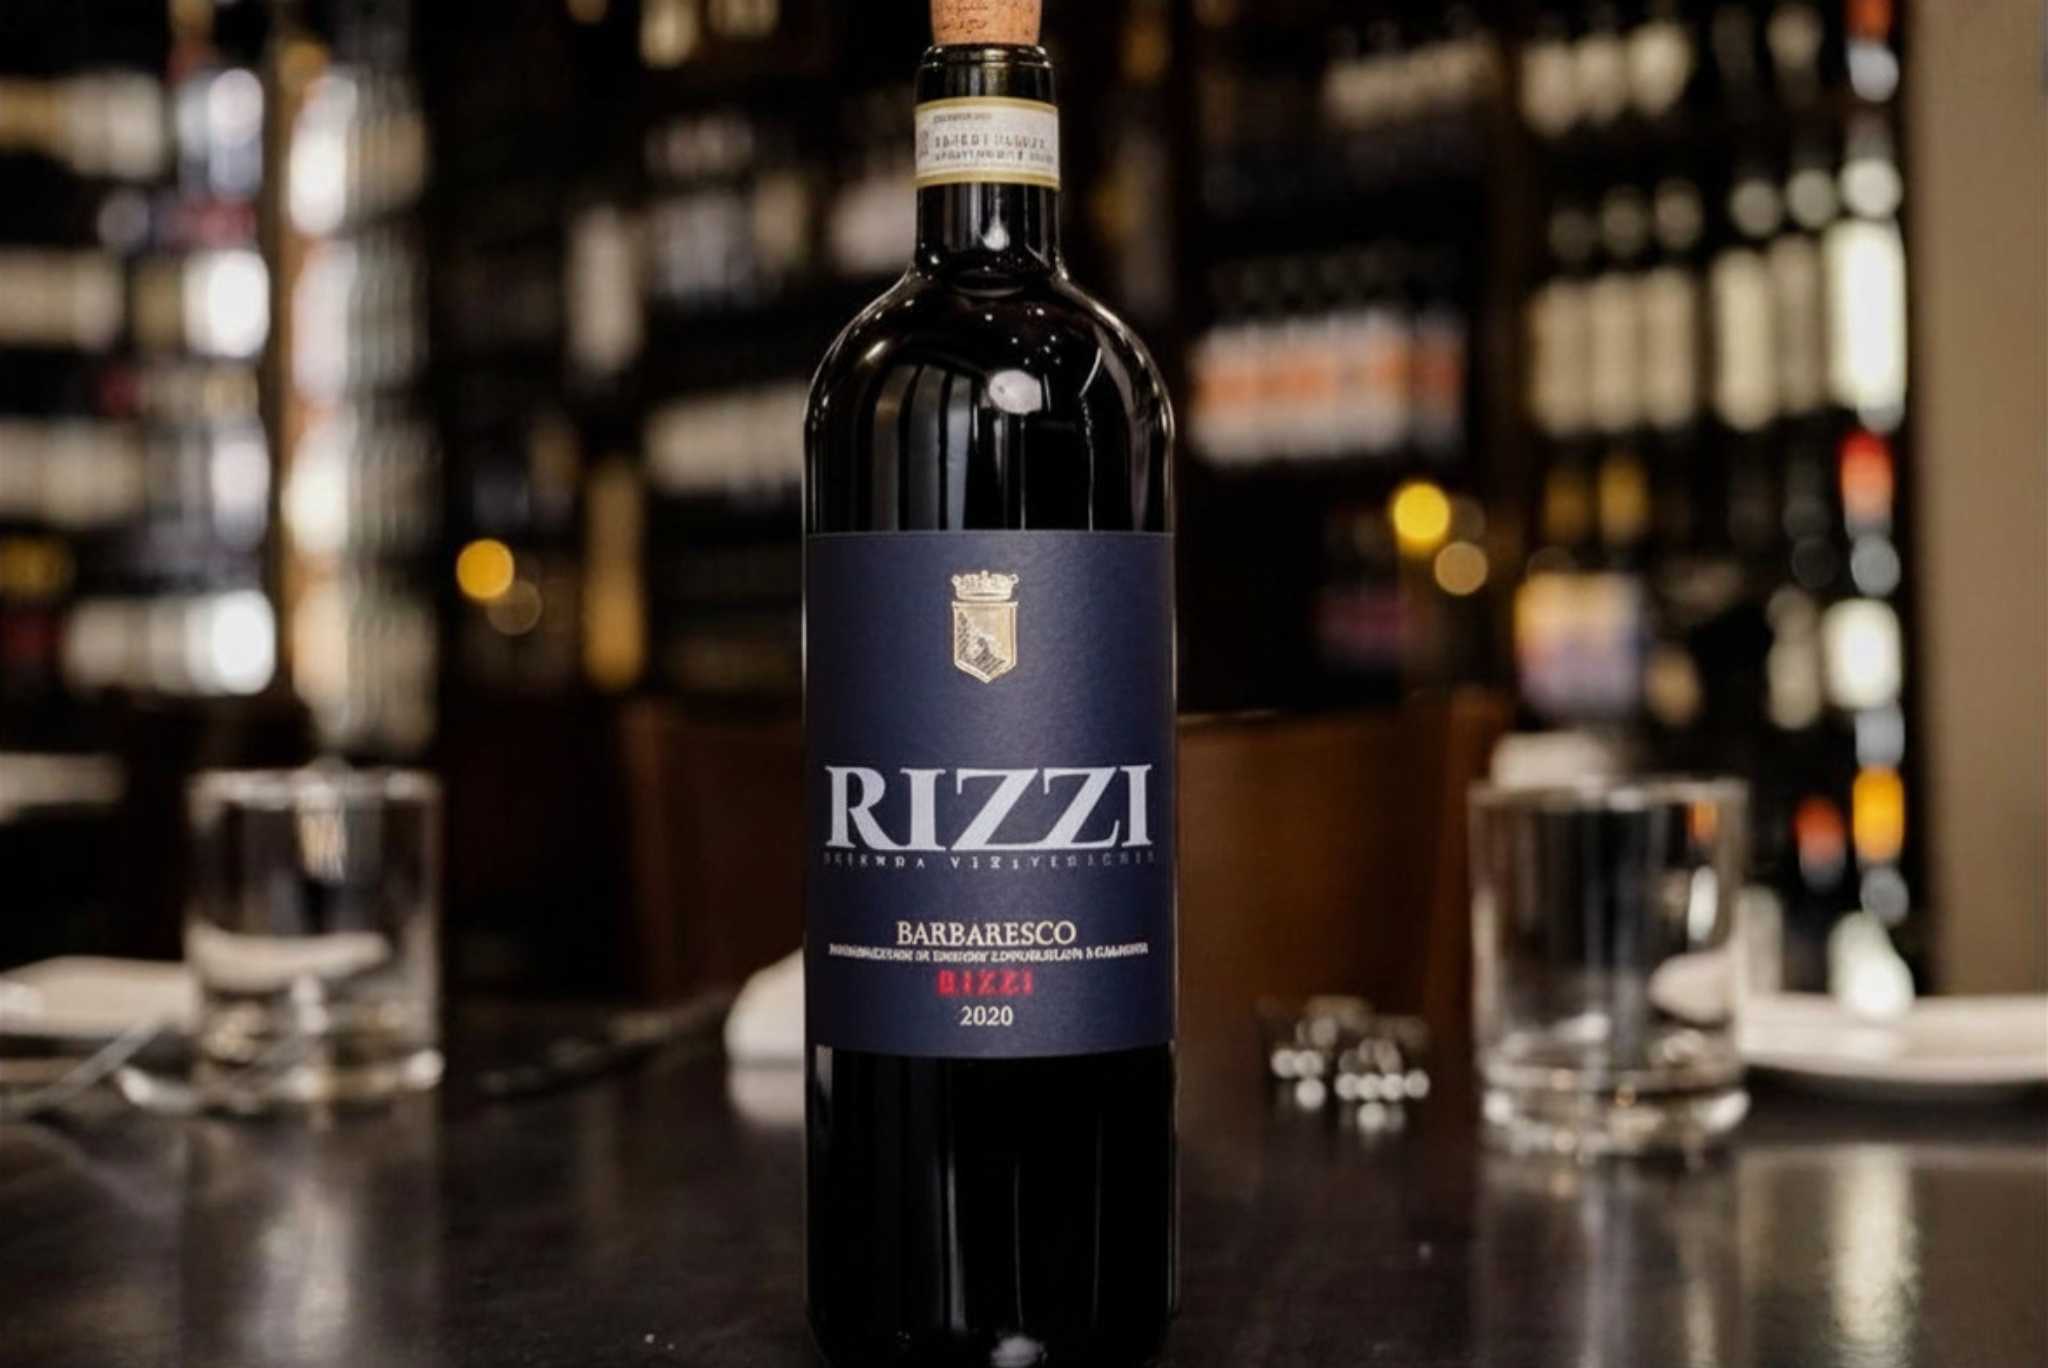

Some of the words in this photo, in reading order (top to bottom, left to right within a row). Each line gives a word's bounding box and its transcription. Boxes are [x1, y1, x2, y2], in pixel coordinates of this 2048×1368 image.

[825, 764, 1152, 852] RIZZI
[897, 920, 1077, 946] BARBARESCO
[960, 1005, 1014, 1026] 2020
